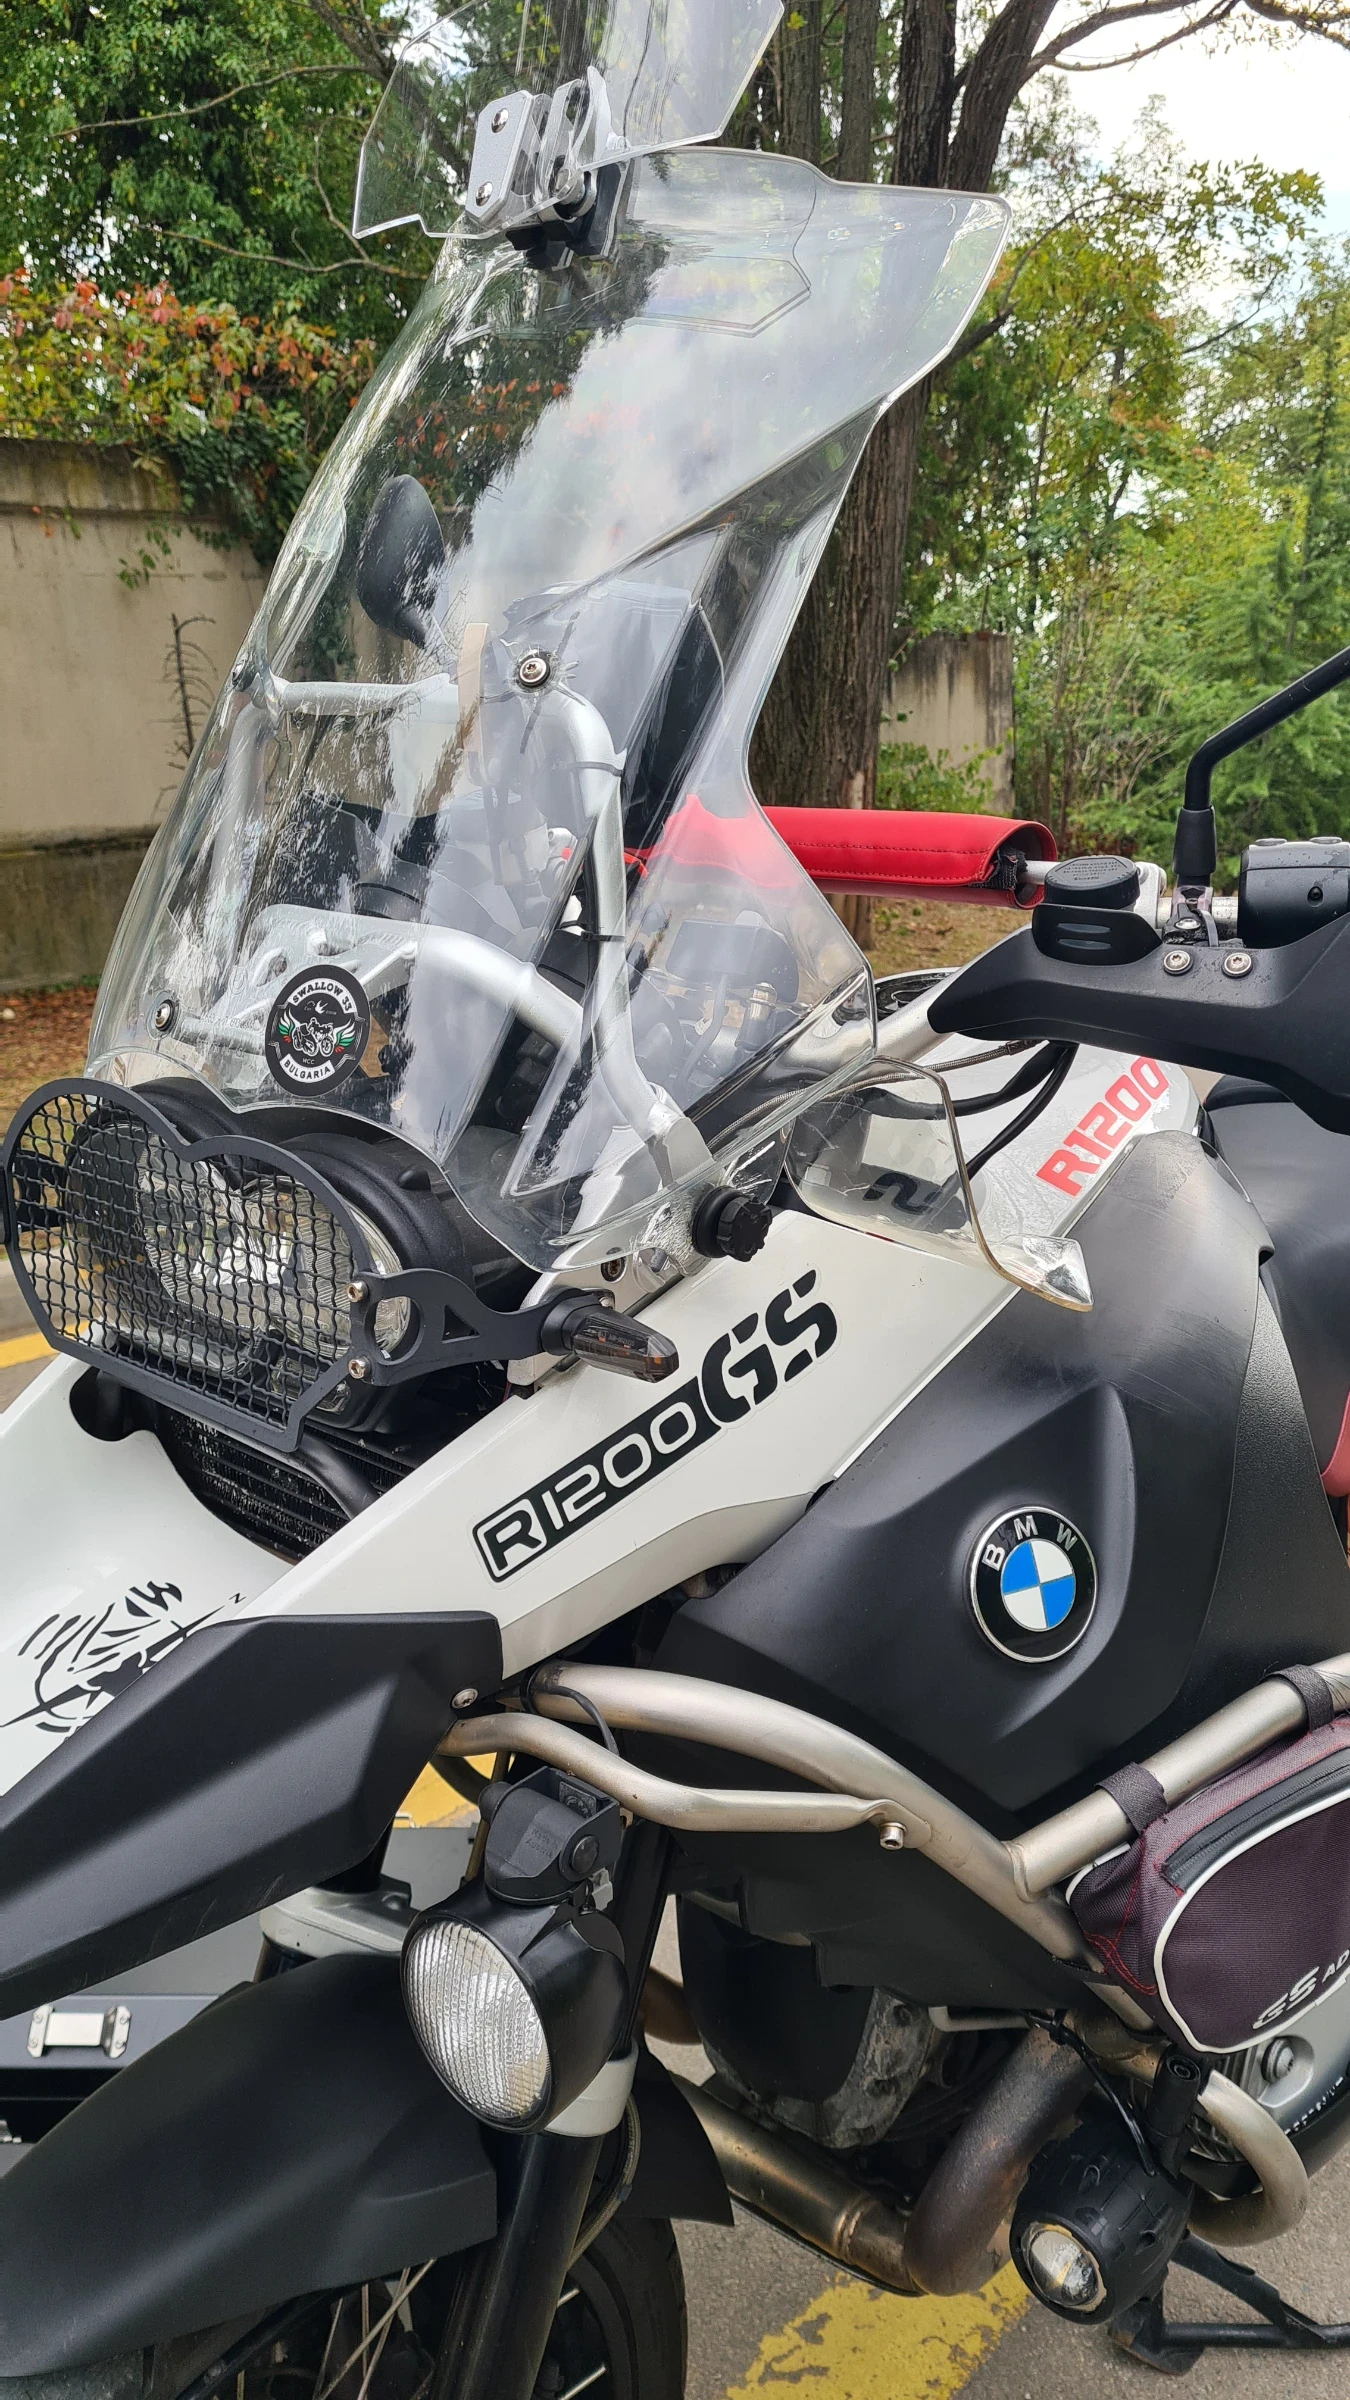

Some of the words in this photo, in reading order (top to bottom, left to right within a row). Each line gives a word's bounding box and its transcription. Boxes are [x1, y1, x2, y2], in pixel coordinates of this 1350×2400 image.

[292, 981, 343, 1003] SWALLOW
[341, 995, 353, 1012] 33
[284, 1060, 331, 1080] BULGARIA
[1036, 1056, 1170, 1198] R1200
[982, 1515, 1078, 1571] BMW
[1252, 1966, 1320, 2030] GS
